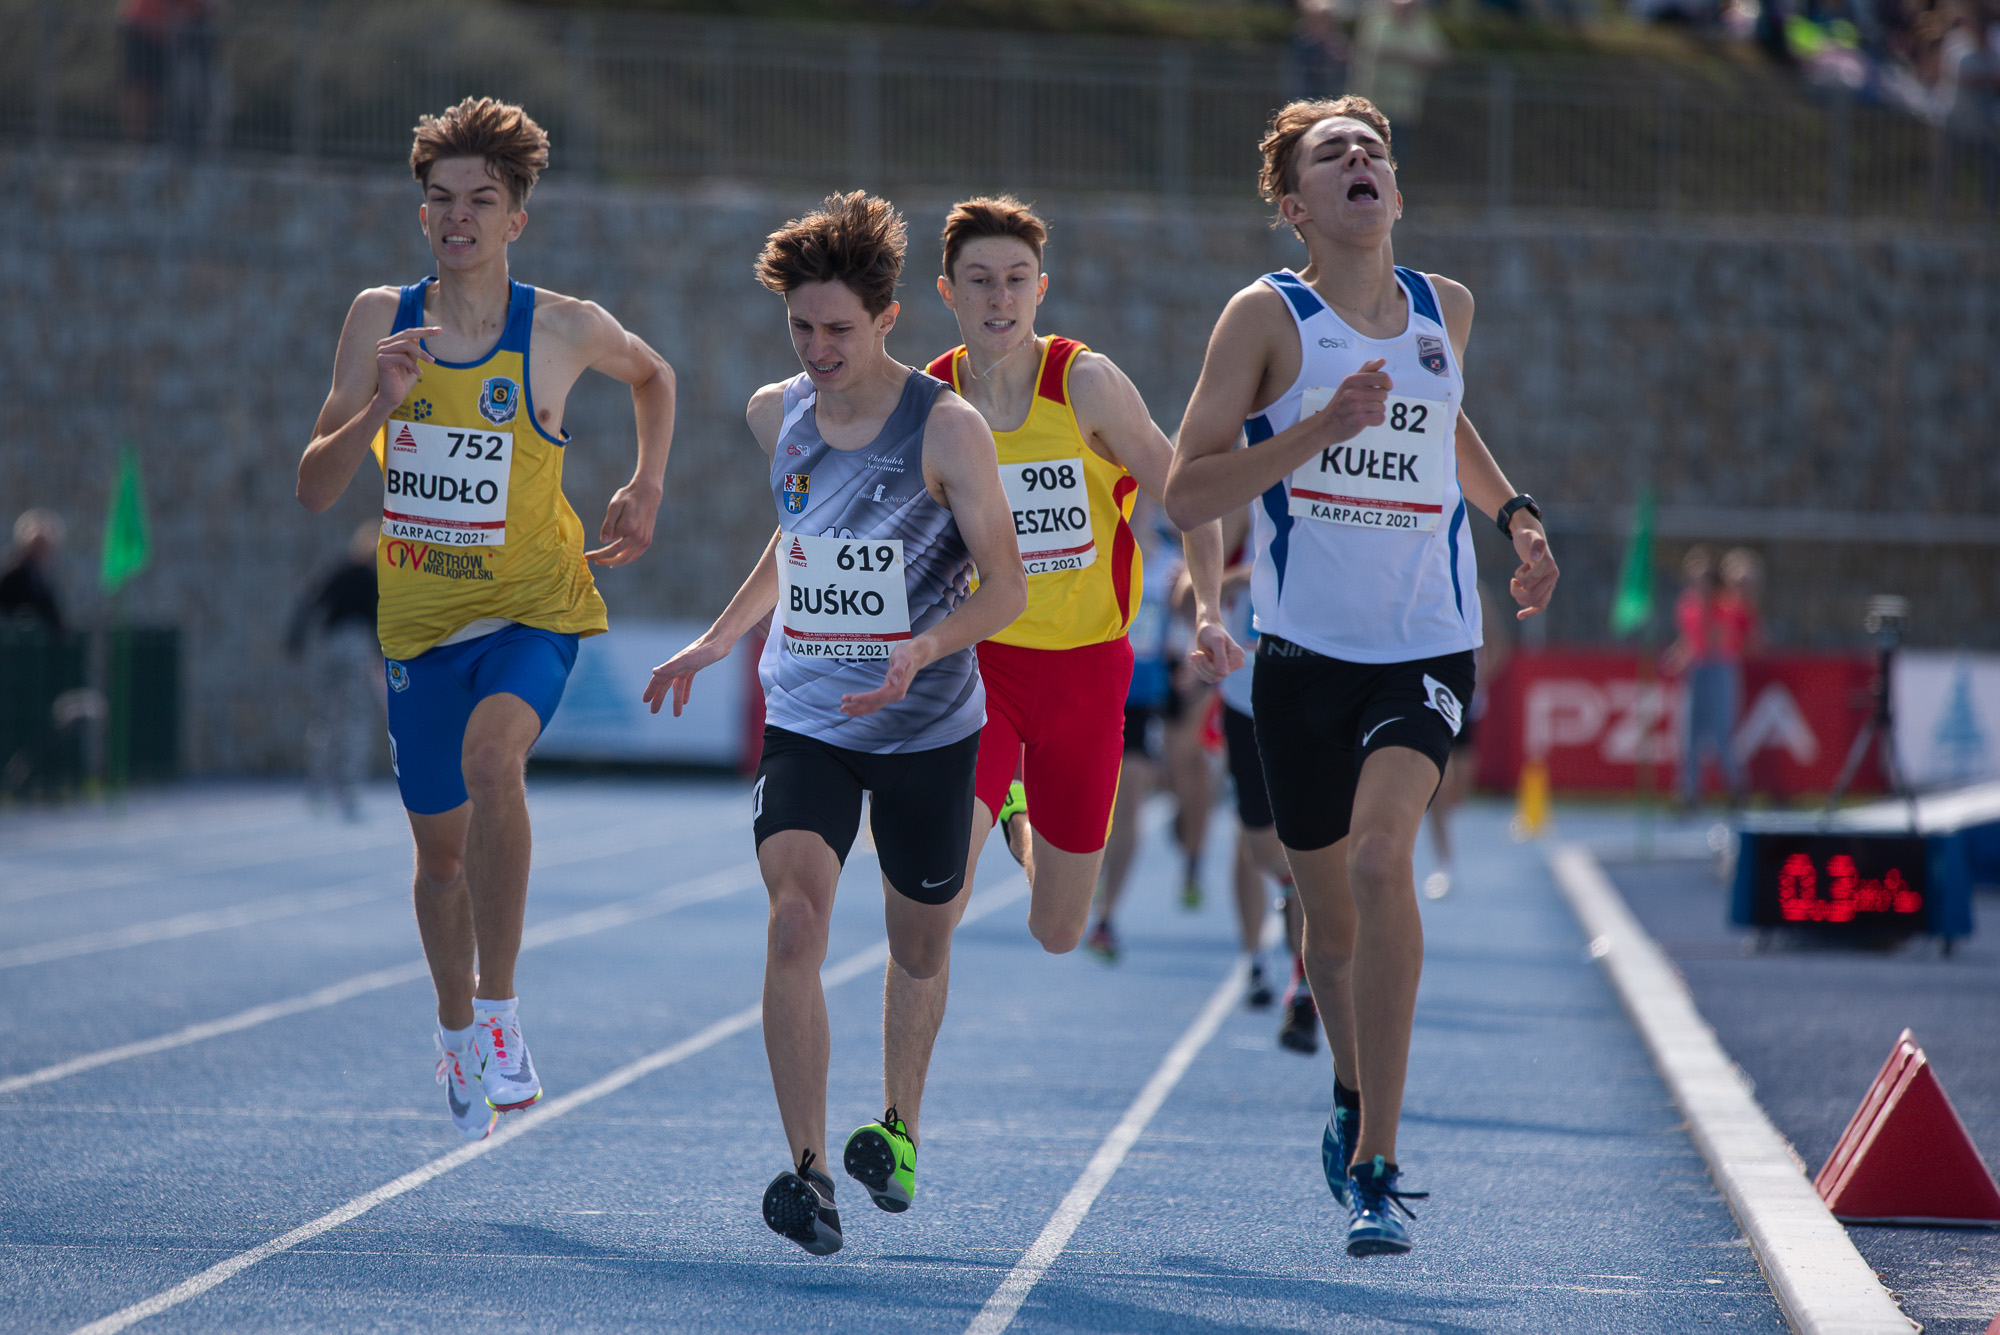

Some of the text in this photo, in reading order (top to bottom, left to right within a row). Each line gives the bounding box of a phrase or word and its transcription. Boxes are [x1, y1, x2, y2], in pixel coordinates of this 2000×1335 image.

[1318, 337, 1349, 349] esa
[496, 389, 504, 400] S
[1390, 402, 1428, 434] 82
[393, 446, 418, 454] KARPACZ
[447, 432, 503, 461] 752
[787, 444, 810, 457] esa
[1320, 446, 1420, 483] KUŁEK
[387, 468, 499, 505] BRUDŁO
[1021, 465, 1077, 492] 908
[1012, 506, 1087, 536] ESZKO
[1311, 504, 1383, 525] KARPACZ
[1385, 513, 1418, 529] 2021
[392, 523, 451, 542] KARPACZ
[455, 532, 485, 544] 2021
[427, 549, 483, 570] OSTRÓW
[788, 559, 808, 568] KARPACZ
[836, 544, 894, 573] 619
[1051, 557, 1083, 571] 2021
[423, 562, 493, 580] WIELKOPOLSKI
[790, 583, 885, 617] BUŚKO
[791, 641, 890, 656] KARPACZ 2021
[1267, 641, 1317, 658] NIK
